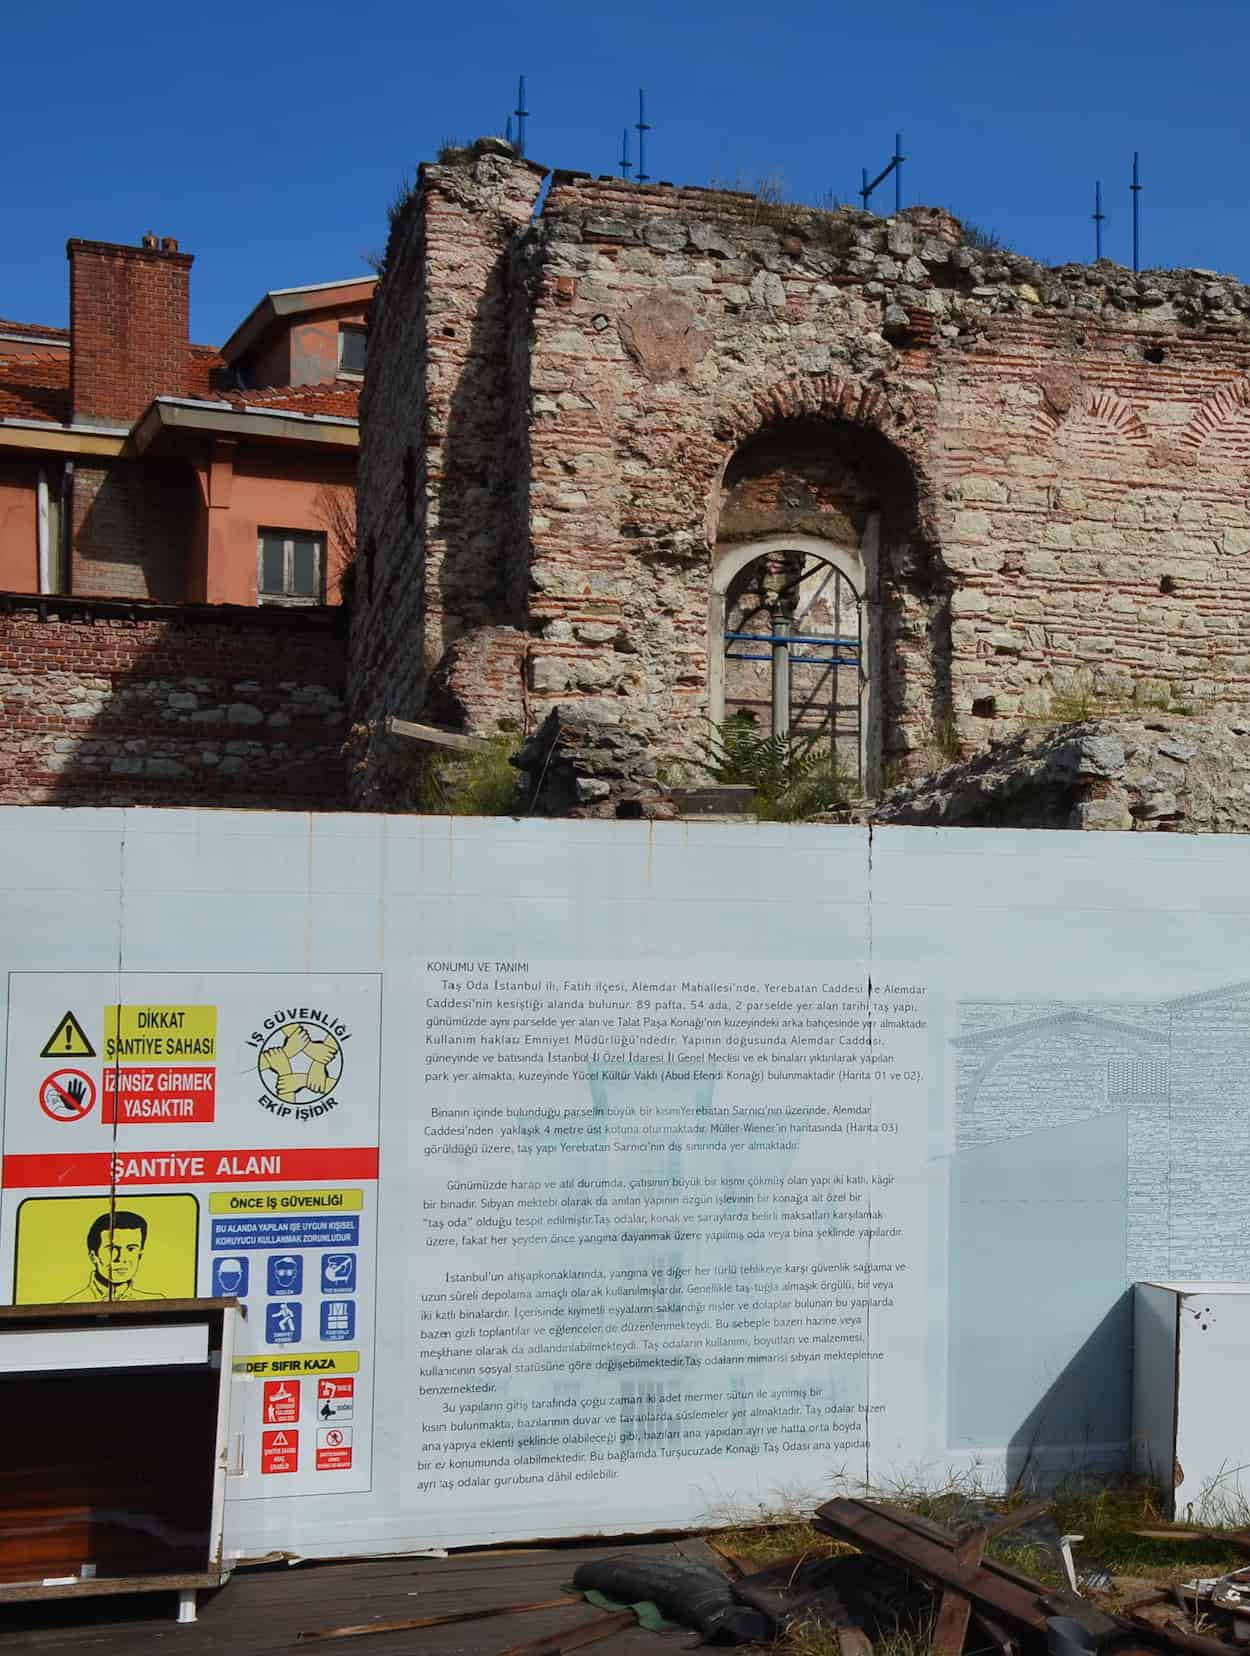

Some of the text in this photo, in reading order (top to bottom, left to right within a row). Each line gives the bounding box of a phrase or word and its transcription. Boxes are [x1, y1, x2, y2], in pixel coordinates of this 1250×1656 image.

[426, 962, 529, 973] KONUMU VE TANIMI
[441, 980, 462, 993] Taş
[466, 980, 488, 990] Oda
[495, 979, 541, 990] İstanbul
[564, 981, 592, 992] Fatih
[632, 982, 676, 992] Alemdar
[764, 983, 818, 993] Yerebatan
[822, 983, 864, 993] Caddesi
[884, 984, 927, 994] Alemdar
[426, 998, 492, 1008] Caddesi'nin
[496, 999, 544, 1012] kesiştiği
[548, 1000, 584, 1008] alanda
[588, 1000, 631, 1009] bulunur.
[636, 1000, 651, 1009] 89
[656, 1000, 686, 1012] pafta,
[690, 1000, 704, 1010] 54
[708, 1000, 731, 1011] ada,
[736, 1001, 742, 1010] 2
[747, 1000, 793, 1013] parselde
[796, 1004, 812, 1012] yer
[816, 1000, 838, 1010] alan
[138, 1008, 184, 1029] DİKKAT
[245, 1007, 352, 1050] İŞ GÜVENLİĞİ
[106, 1038, 214, 1058] ŞANTİYE SAHASI
[426, 1034, 476, 1044] Kullanım
[524, 1034, 569, 1047] Emniyet
[682, 1035, 721, 1048] Yapının
[726, 1034, 786, 1047] doğusunda
[790, 1036, 835, 1046] Alemdar
[104, 1070, 213, 1092] İZİNSİZ GİRMEK
[424, 1072, 448, 1083] park
[452, 1074, 469, 1083] yer
[472, 1072, 516, 1082] almakta,
[518, 1072, 569, 1083] kuzeyinde
[572, 1070, 599, 1081] Yücel
[602, 1070, 630, 1080] Kültür
[660, 1070, 690, 1082] (Abud
[694, 1070, 723, 1080] Efendi
[726, 1070, 764, 1084] Konağı)
[768, 1070, 835, 1080] bulunmaktadır
[838, 1070, 871, 1083] (Harita
[874, 1071, 886, 1080] 01
[124, 1098, 194, 1117] YASAKTIR
[258, 1094, 340, 1122] EKİP İŞİDİR
[110, 1154, 280, 1182] ŞANTİYE ALANI
[230, 1194, 343, 1210] ÖNCE İŞ GÜVENLİĞİ
[216, 1224, 226, 1233] BU
[226, 1224, 257, 1232] ALANDA
[258, 1222, 288, 1232] YAPILAN
[272, 1360, 300, 1372] SIFIR
[304, 1360, 336, 1370] KAZA
[420, 1383, 497, 1396] benzemektedir.
[418, 1460, 432, 1470] bir
[450, 1457, 510, 1469] konumunda
[514, 1452, 586, 1466] olabilmektedir.
[590, 1452, 604, 1462] Bu
[608, 1449, 656, 1462] bağlamda
[726, 1444, 760, 1456] Konağı
[764, 1442, 779, 1455] Taş
[782, 1441, 810, 1452] Odası
[458, 1477, 490, 1488] odalar
[494, 1474, 544, 1488] gurubuna
[576, 1468, 619, 1481] edilebilir.
